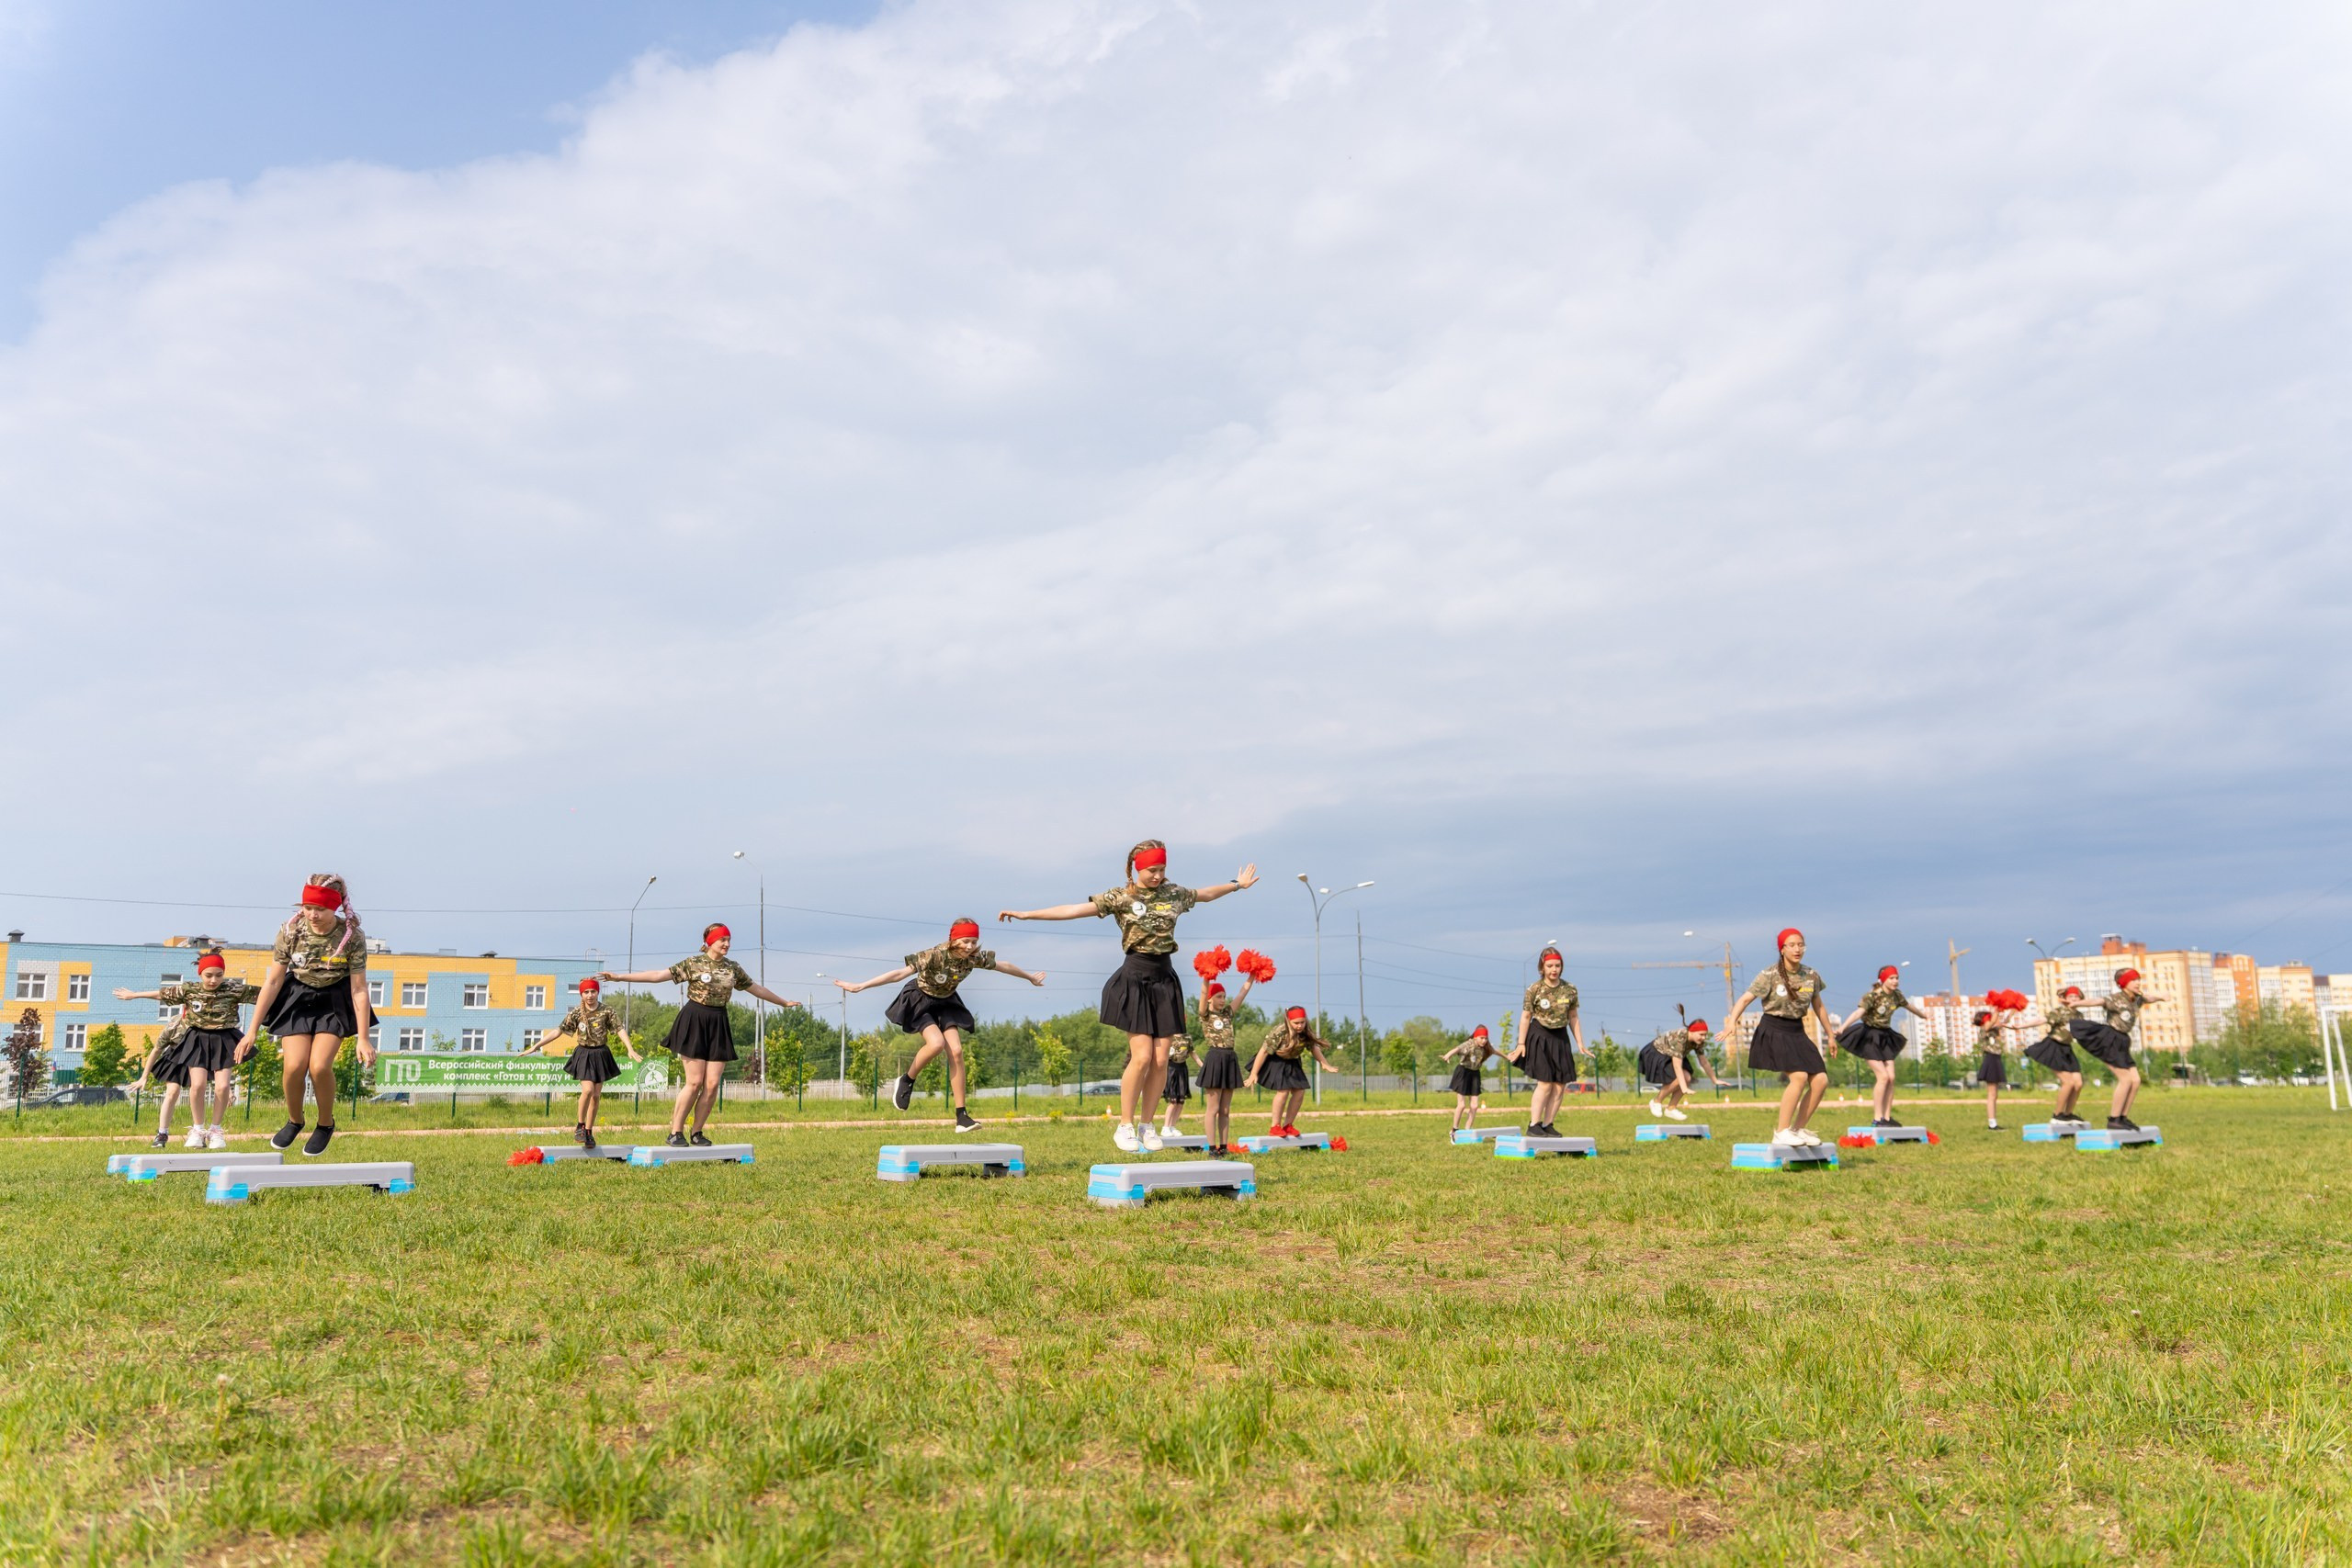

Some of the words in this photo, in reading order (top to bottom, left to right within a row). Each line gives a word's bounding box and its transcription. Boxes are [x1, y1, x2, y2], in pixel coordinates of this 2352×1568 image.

[385, 1059, 421, 1082] ГТО
[428, 1060, 503, 1071] Всероссийский
[493, 1071, 525, 1080] «Готов
[536, 1073, 562, 1082] труду
